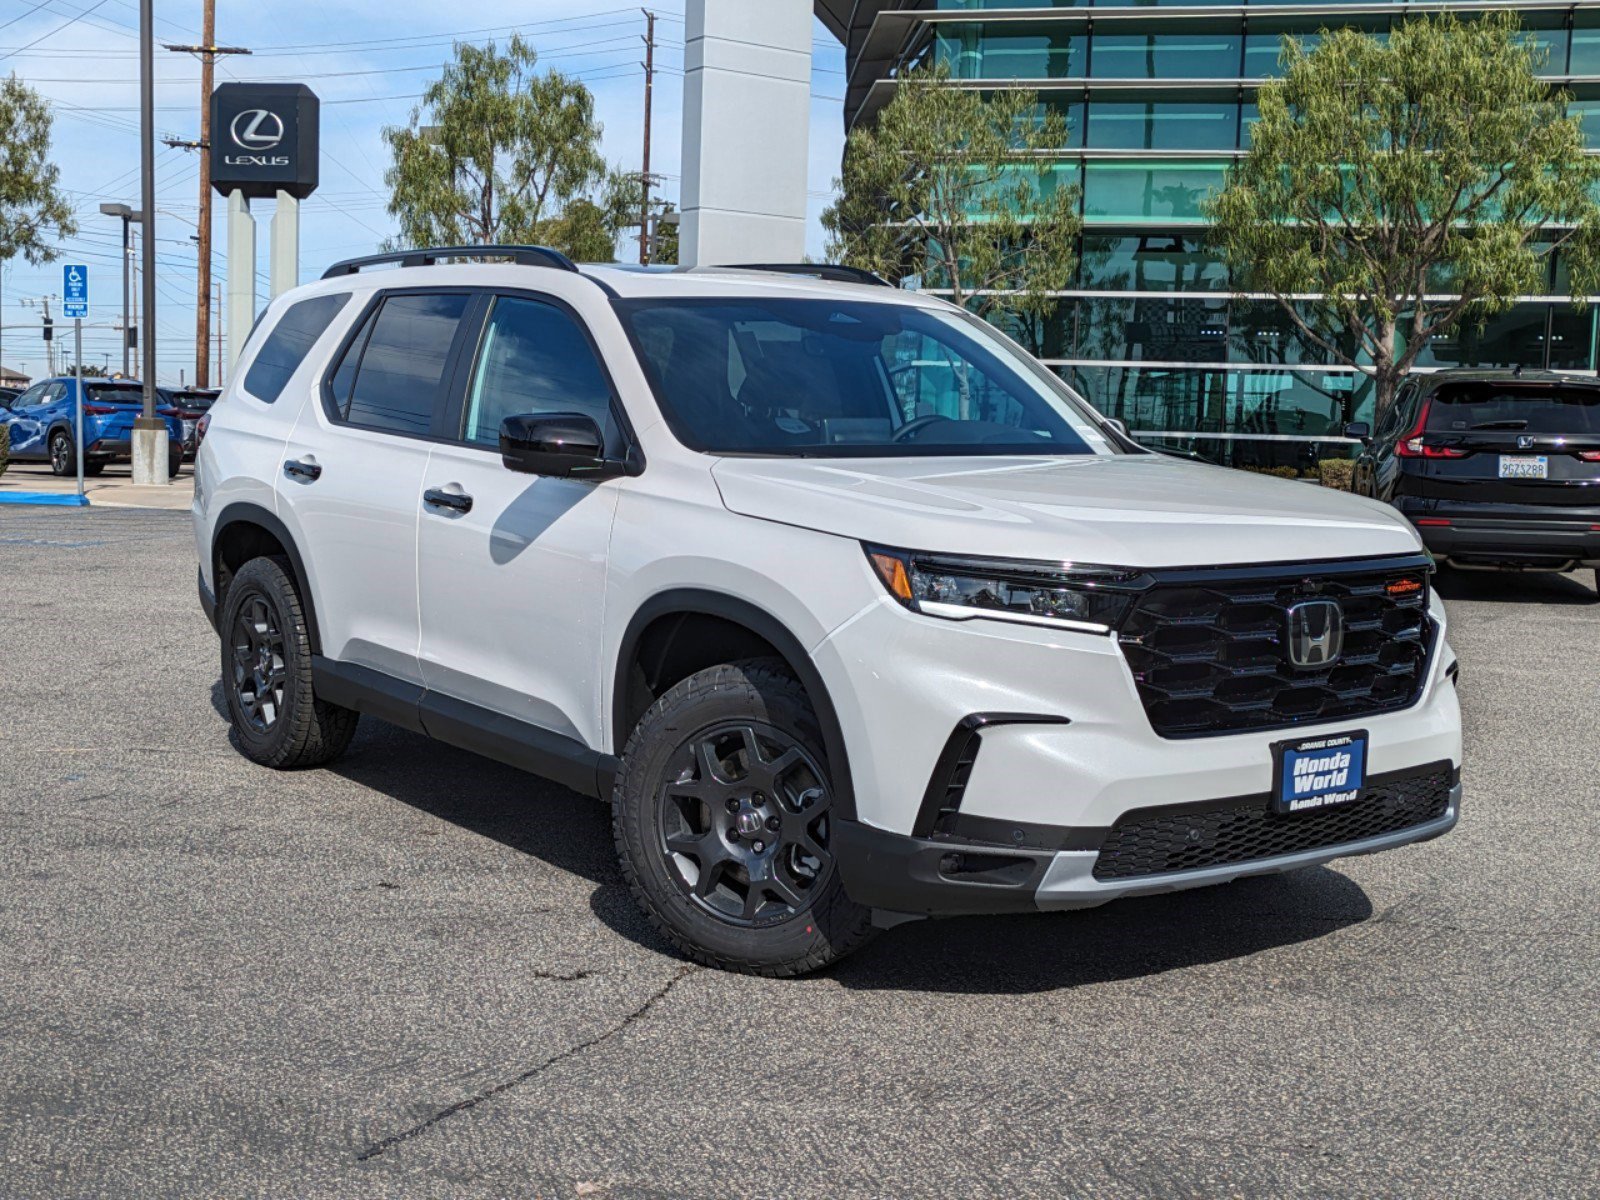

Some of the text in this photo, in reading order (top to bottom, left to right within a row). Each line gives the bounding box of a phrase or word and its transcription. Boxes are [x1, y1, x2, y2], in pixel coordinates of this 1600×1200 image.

[225, 155, 289, 166] LEXUS
[1293, 752, 1351, 776] Honda
[1294, 768, 1348, 794] World
[1289, 796, 1323, 811] Honda
